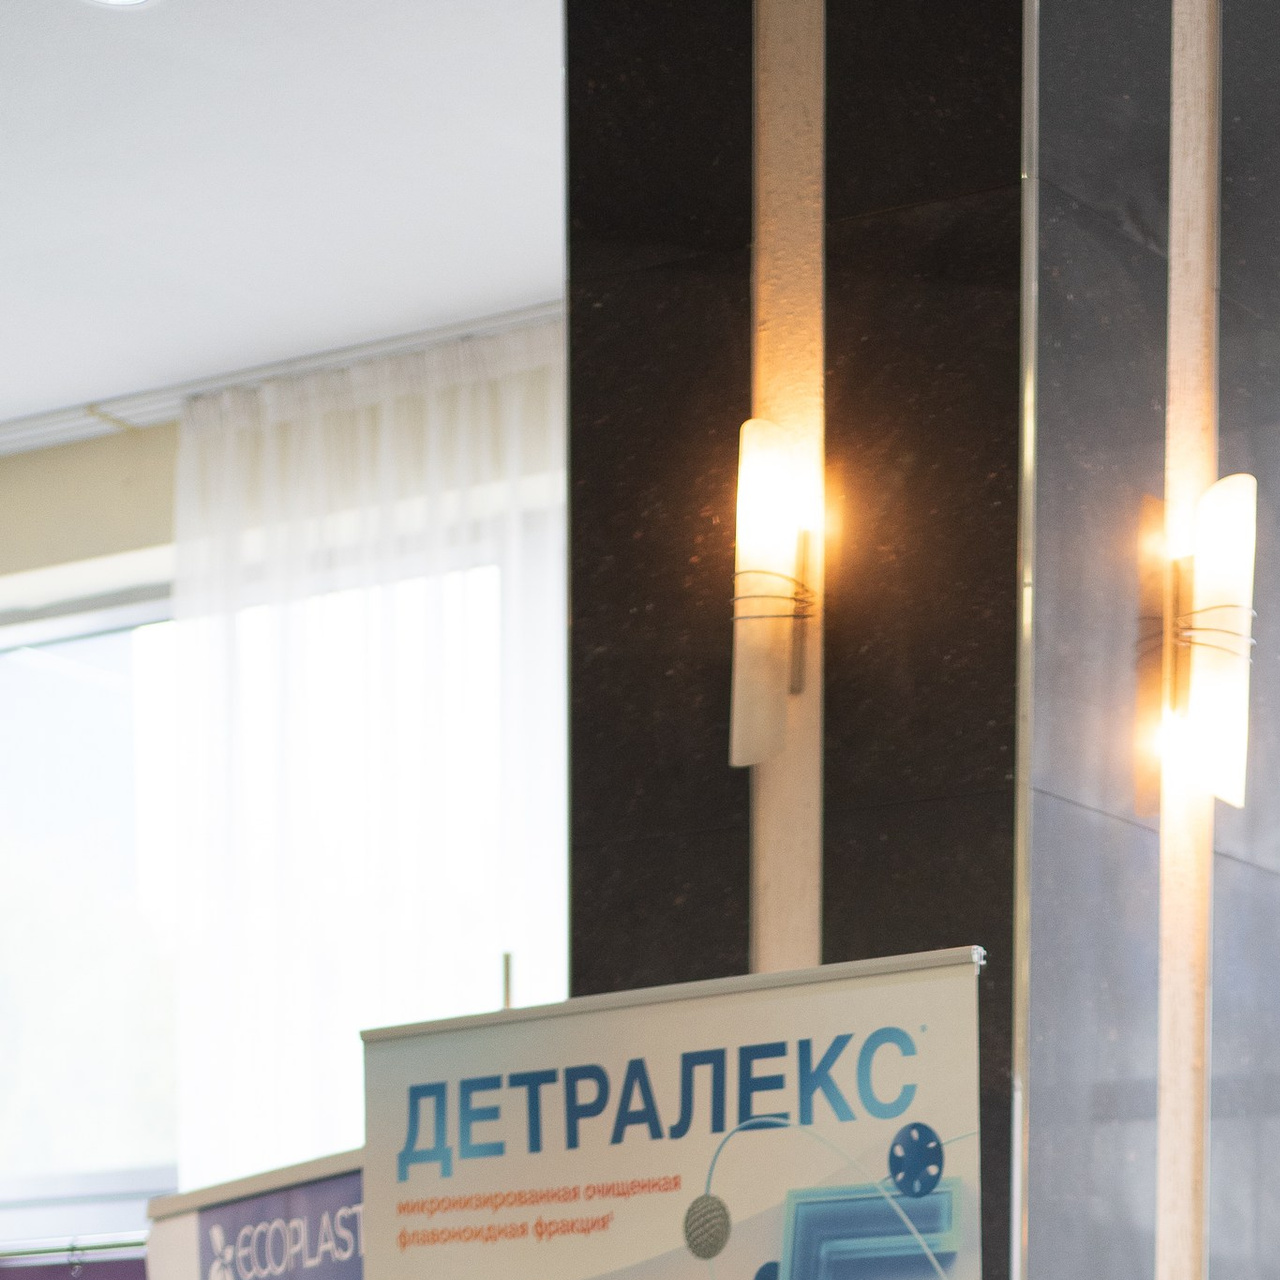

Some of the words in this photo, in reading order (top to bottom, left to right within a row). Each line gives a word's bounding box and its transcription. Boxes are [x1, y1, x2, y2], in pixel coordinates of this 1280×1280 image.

[396, 1184, 581, 1217] микронизированная
[584, 1174, 682, 1200] очищенная
[236, 1204, 364, 1280] ECOPLAST
[396, 1220, 529, 1250] флавоноидная
